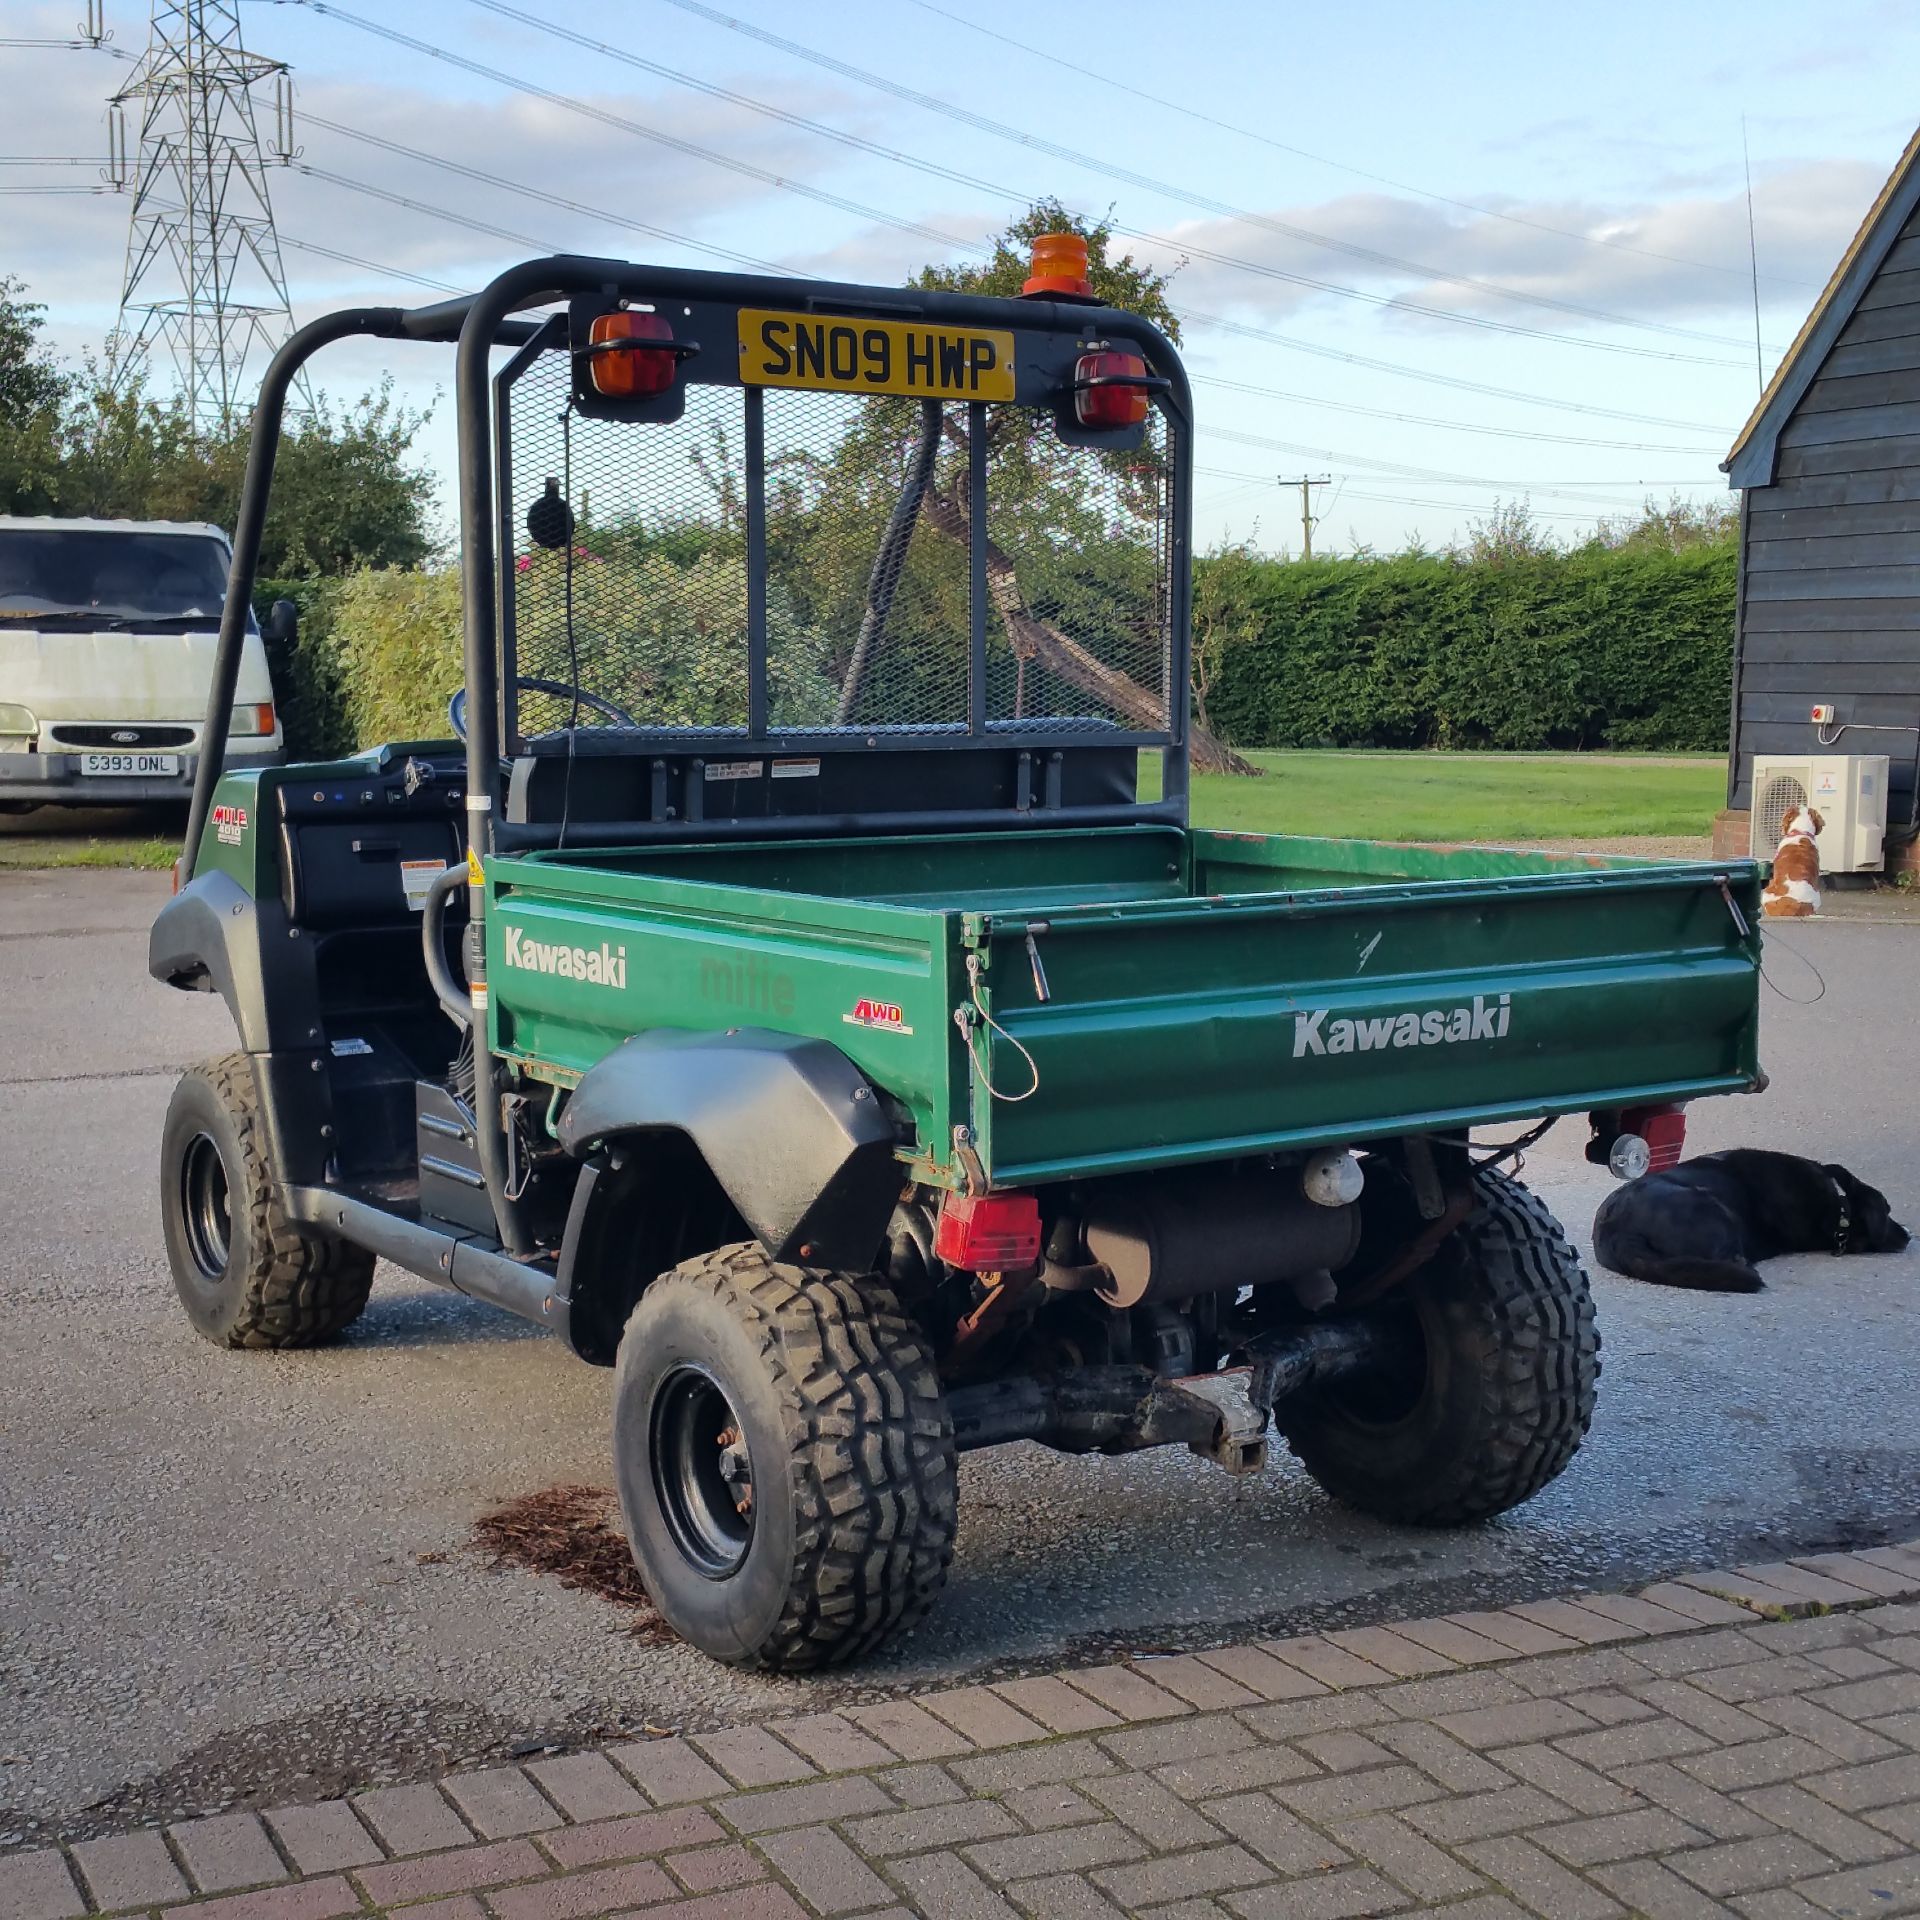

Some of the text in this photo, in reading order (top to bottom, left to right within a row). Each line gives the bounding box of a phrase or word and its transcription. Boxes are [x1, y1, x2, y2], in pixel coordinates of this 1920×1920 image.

[761, 320, 997, 391] SN09 HWP
[89, 755, 170, 771] S393 ONL
[212, 805, 248, 829] MULE
[504, 926, 626, 989] Kawasaki
[853, 998, 903, 1028] 4WD
[1292, 994, 1511, 1058] Kawasaki
